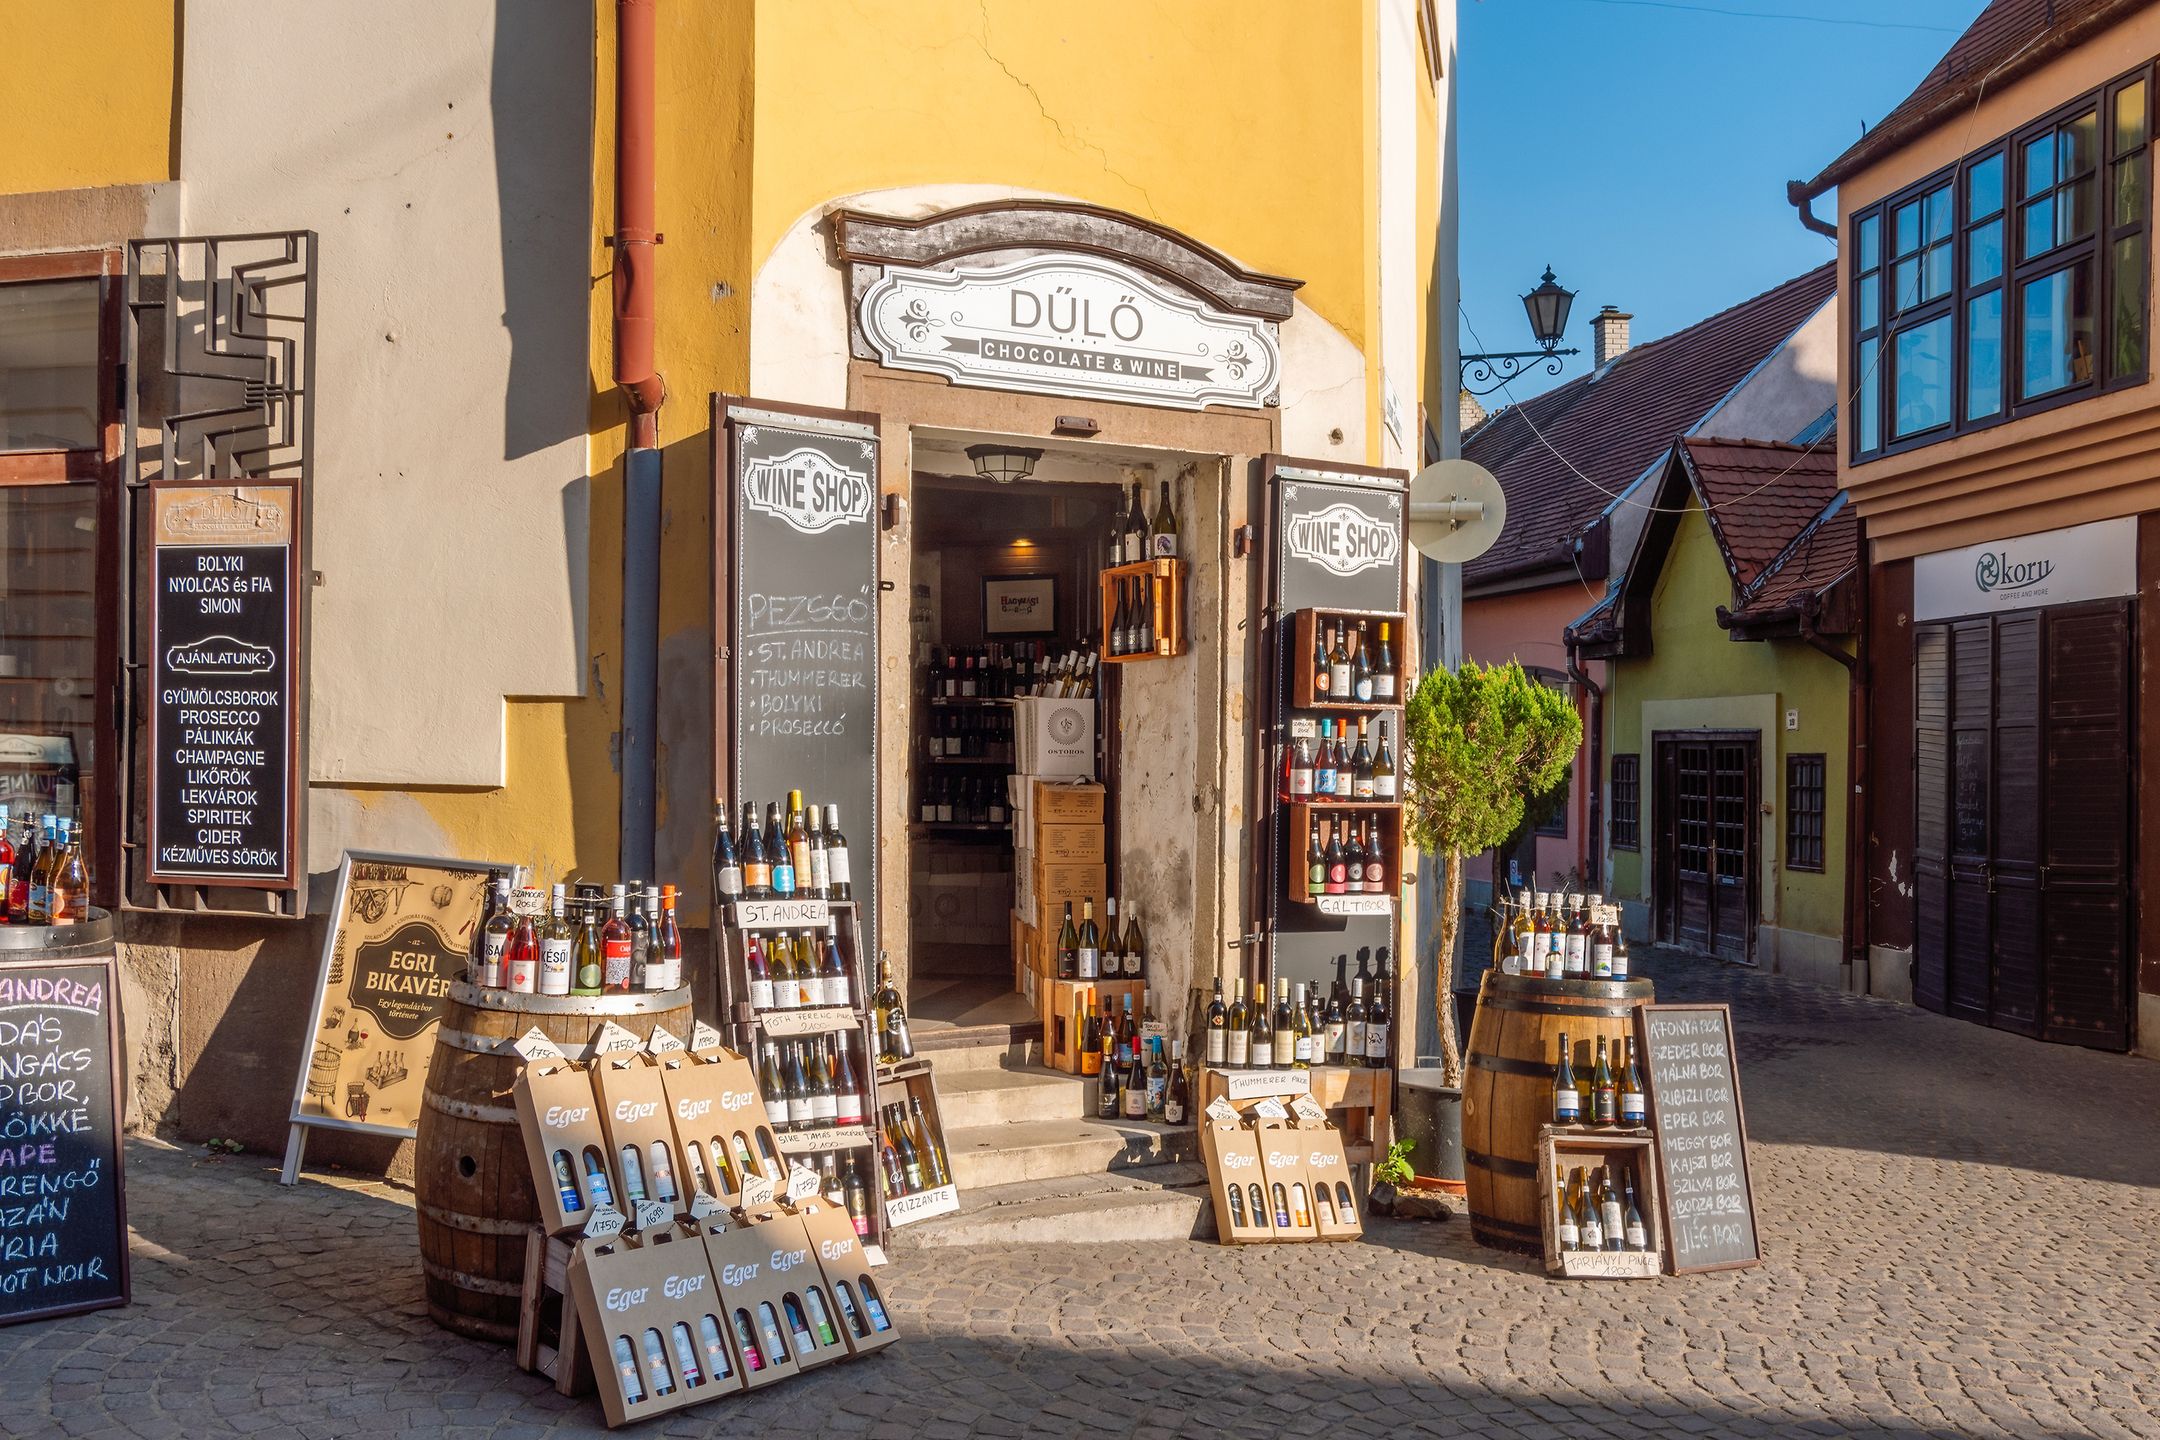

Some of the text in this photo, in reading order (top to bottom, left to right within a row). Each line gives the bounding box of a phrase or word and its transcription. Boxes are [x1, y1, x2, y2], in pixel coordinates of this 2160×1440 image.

[1010, 286, 1143, 342] DŰLŐ
[984, 342, 1177, 378] CHOCOLATE & WINE
[756, 468, 863, 514] WINE SHOP
[1298, 522, 1390, 558] WINE SHOP
[198, 556, 243, 571] BOLYKI
[2000, 552, 2054, 585] koru
[169, 577, 272, 593] NYOLCAS és FIA
[2000, 588, 2049, 600] COFFEE AND MORE
[201, 598, 240, 613] SIMON
[176, 649, 266, 665] AJÁNLATUNK:
[757, 641, 864, 664] ST. ANDREA
[164, 688, 278, 706] GYÜMÖLCSBOROK
[760, 695, 823, 716] BOLYKI
[180, 710, 259, 725] PROSECCO
[185, 727, 254, 745] PÁLINKÁK
[176, 749, 265, 765] CHAMPAGNE
[188, 767, 250, 785] LIKŐRÖK
[182, 787, 257, 805] LEKVÁROK
[188, 809, 252, 825] SPIRITEK
[198, 829, 241, 845] CIDER
[162, 845, 277, 866] KÉZMŰVES SÖRÖK
[745, 904, 826, 922] ST. ANDREA
[1320, 898, 1386, 912] GÁL TIBOR
[389, 950, 436, 973] EGRI
[366, 972, 451, 998] BIKAVÉR
[1700, 1019, 1724, 1034] BOR
[1702, 1042, 1726, 1058] BOR
[1231, 1076, 1286, 1090] THUMMERER
[1655, 1063, 1725, 1083] MÁLNA BOR
[721, 1090, 754, 1111] Eger
[1705, 1087, 1729, 1103] BOR
[545, 1106, 590, 1129] Eger
[615, 1099, 658, 1123] Eger
[678, 1098, 712, 1120] Eger
[1663, 1110, 1726, 1130] EPER BOR
[1667, 1133, 1732, 1151] MEGGY BOR
[1224, 1152, 1256, 1169] Eger
[1268, 1151, 1299, 1169] Eger
[1309, 1151, 1339, 1169] Eger
[1670, 1152, 1734, 1175] KAJSZI BOR
[1673, 1173, 1739, 1195] SZILVA BOR
[890, 1191, 949, 1216] FRIZZANTE
[1676, 1194, 1742, 1215] BODZA BOR
[821, 1238, 854, 1260] Eger
[770, 1248, 807, 1272] Eger
[44, 1256, 108, 1287] NOIR
[722, 1262, 759, 1287] Eger
[663, 1272, 705, 1299] Eger
[606, 1286, 649, 1312] Eger
